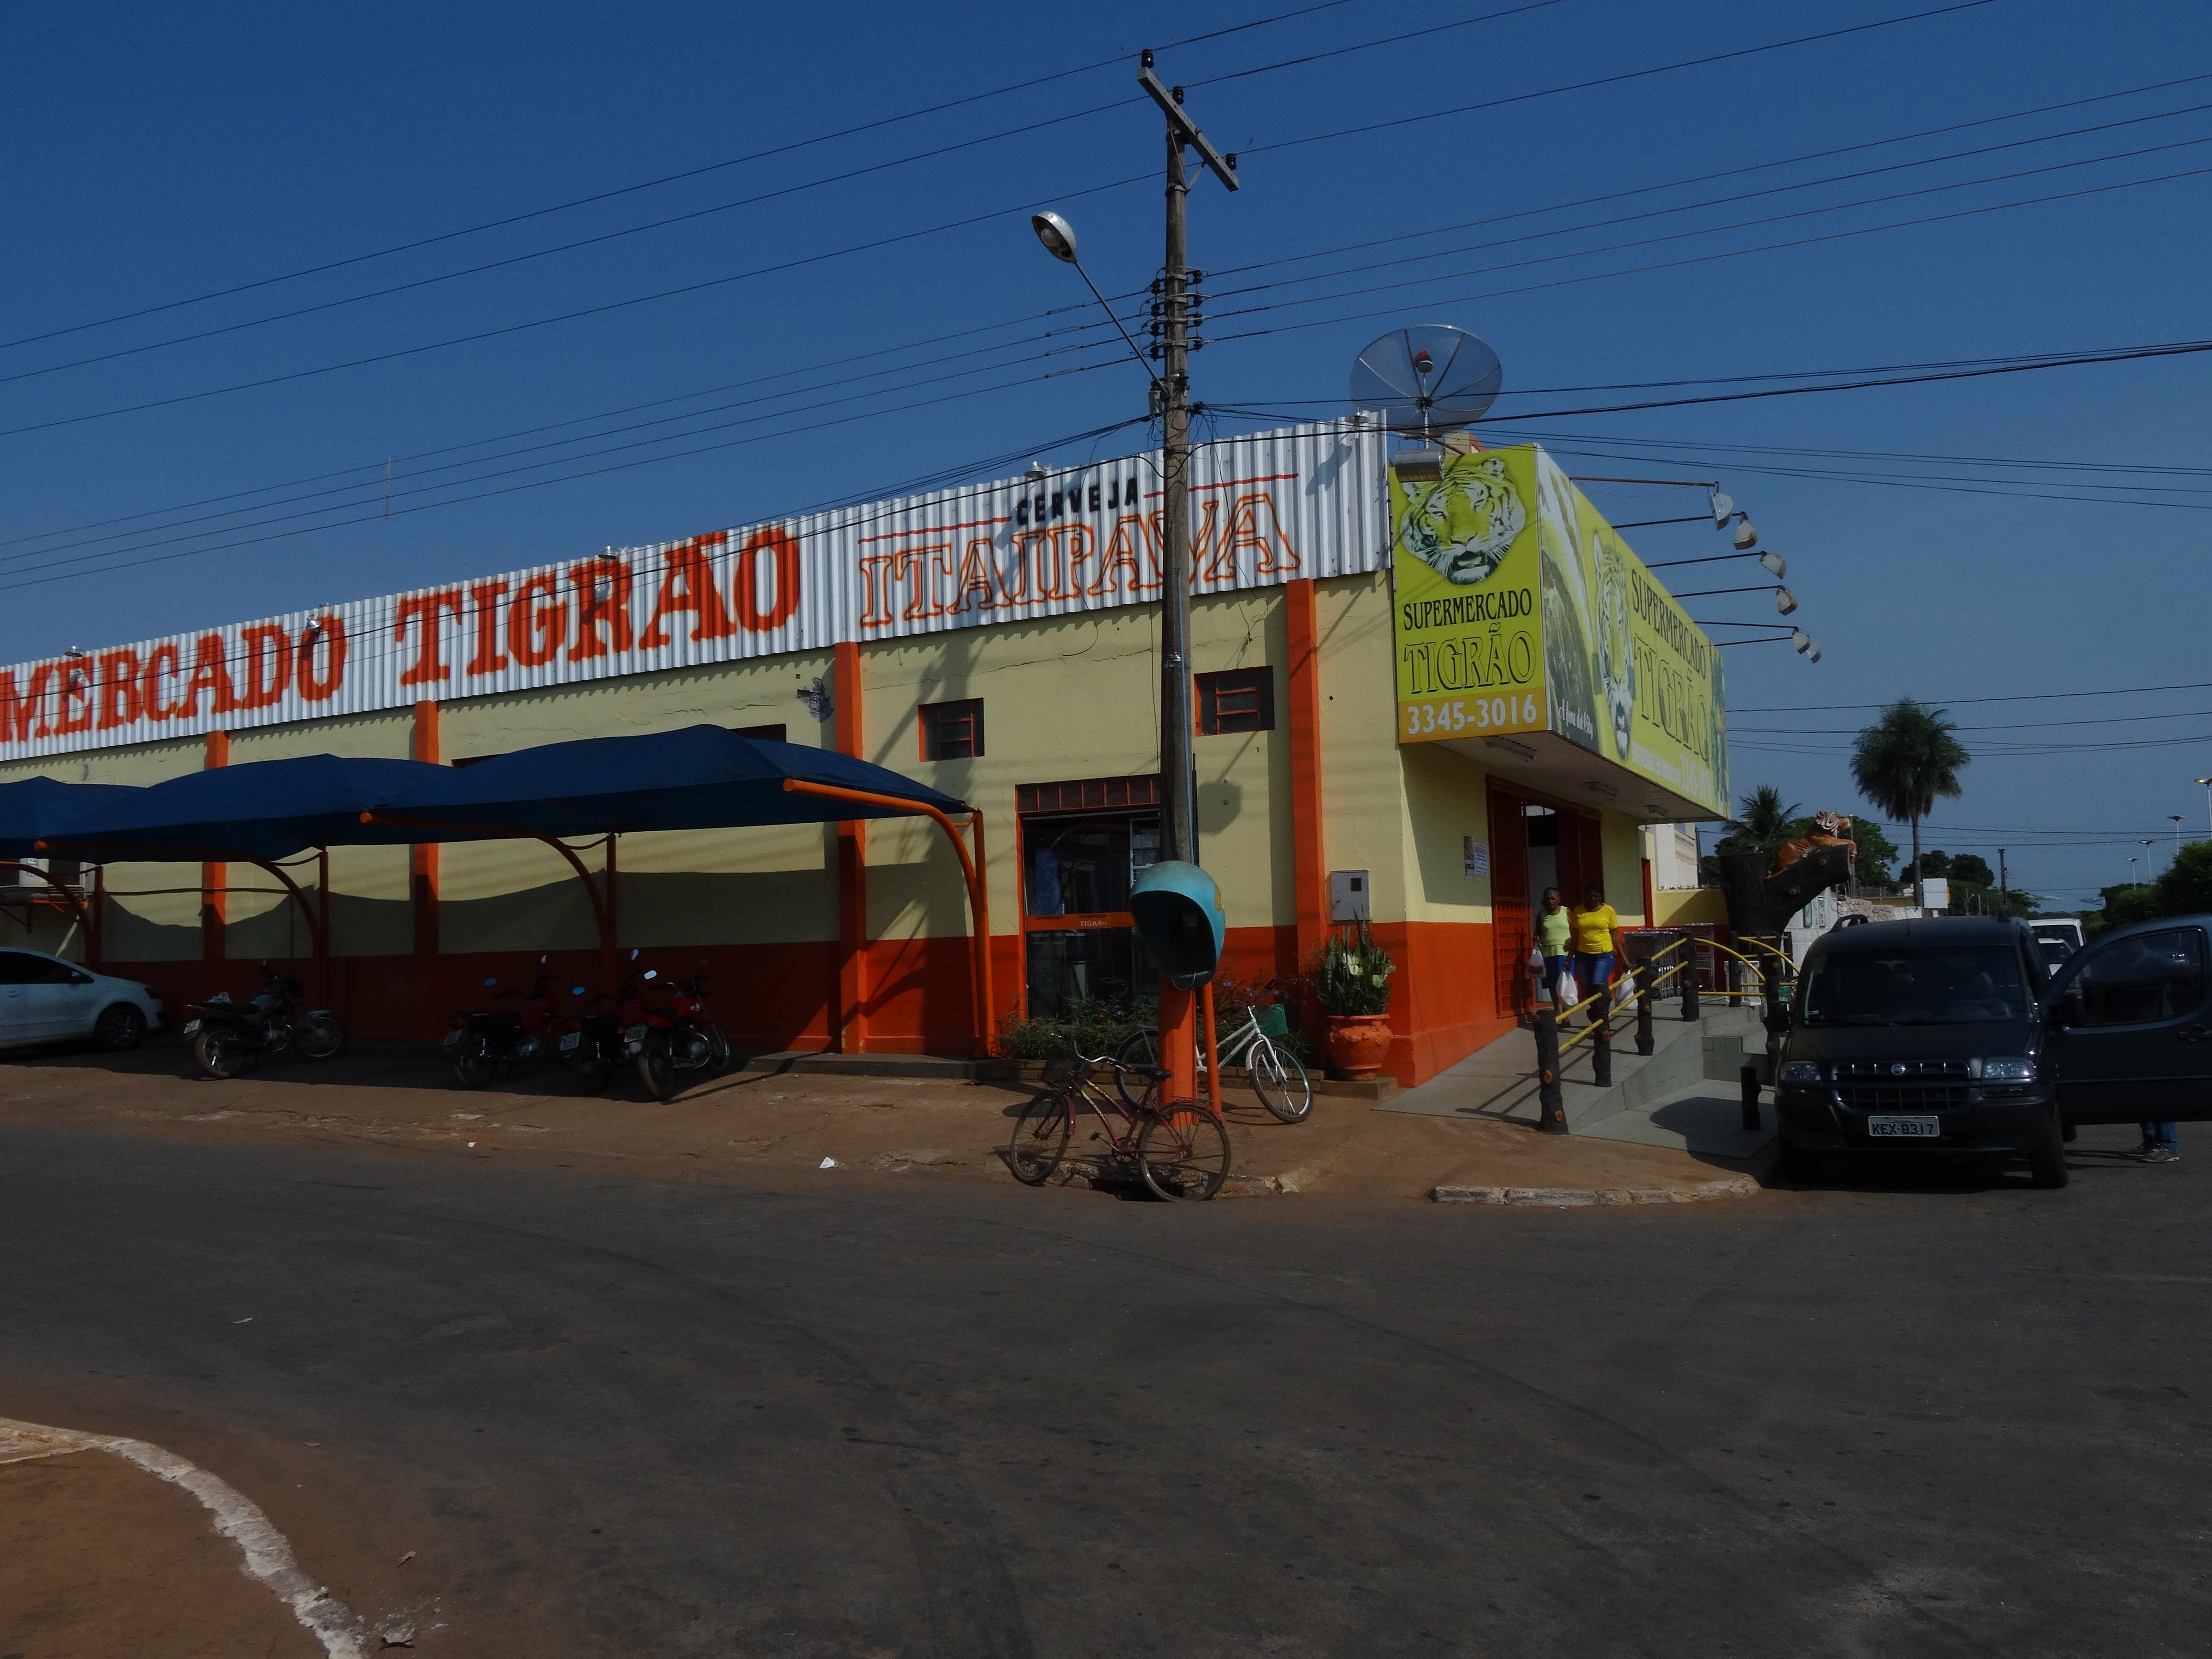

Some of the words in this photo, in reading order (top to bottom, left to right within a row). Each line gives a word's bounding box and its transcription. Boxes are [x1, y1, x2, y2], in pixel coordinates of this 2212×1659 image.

[1016, 477, 1138, 526] CERVEJA
[1403, 588, 1532, 631] SUPERMERCADO
[1631, 569, 1706, 680] SUPERMERCADO
[0, 613, 348, 742] MERCADO
[1404, 622, 1536, 694] TIGRÃO
[1408, 694, 1537, 734] 3345-3016
[1634, 632, 1708, 762] TIGRÃO
